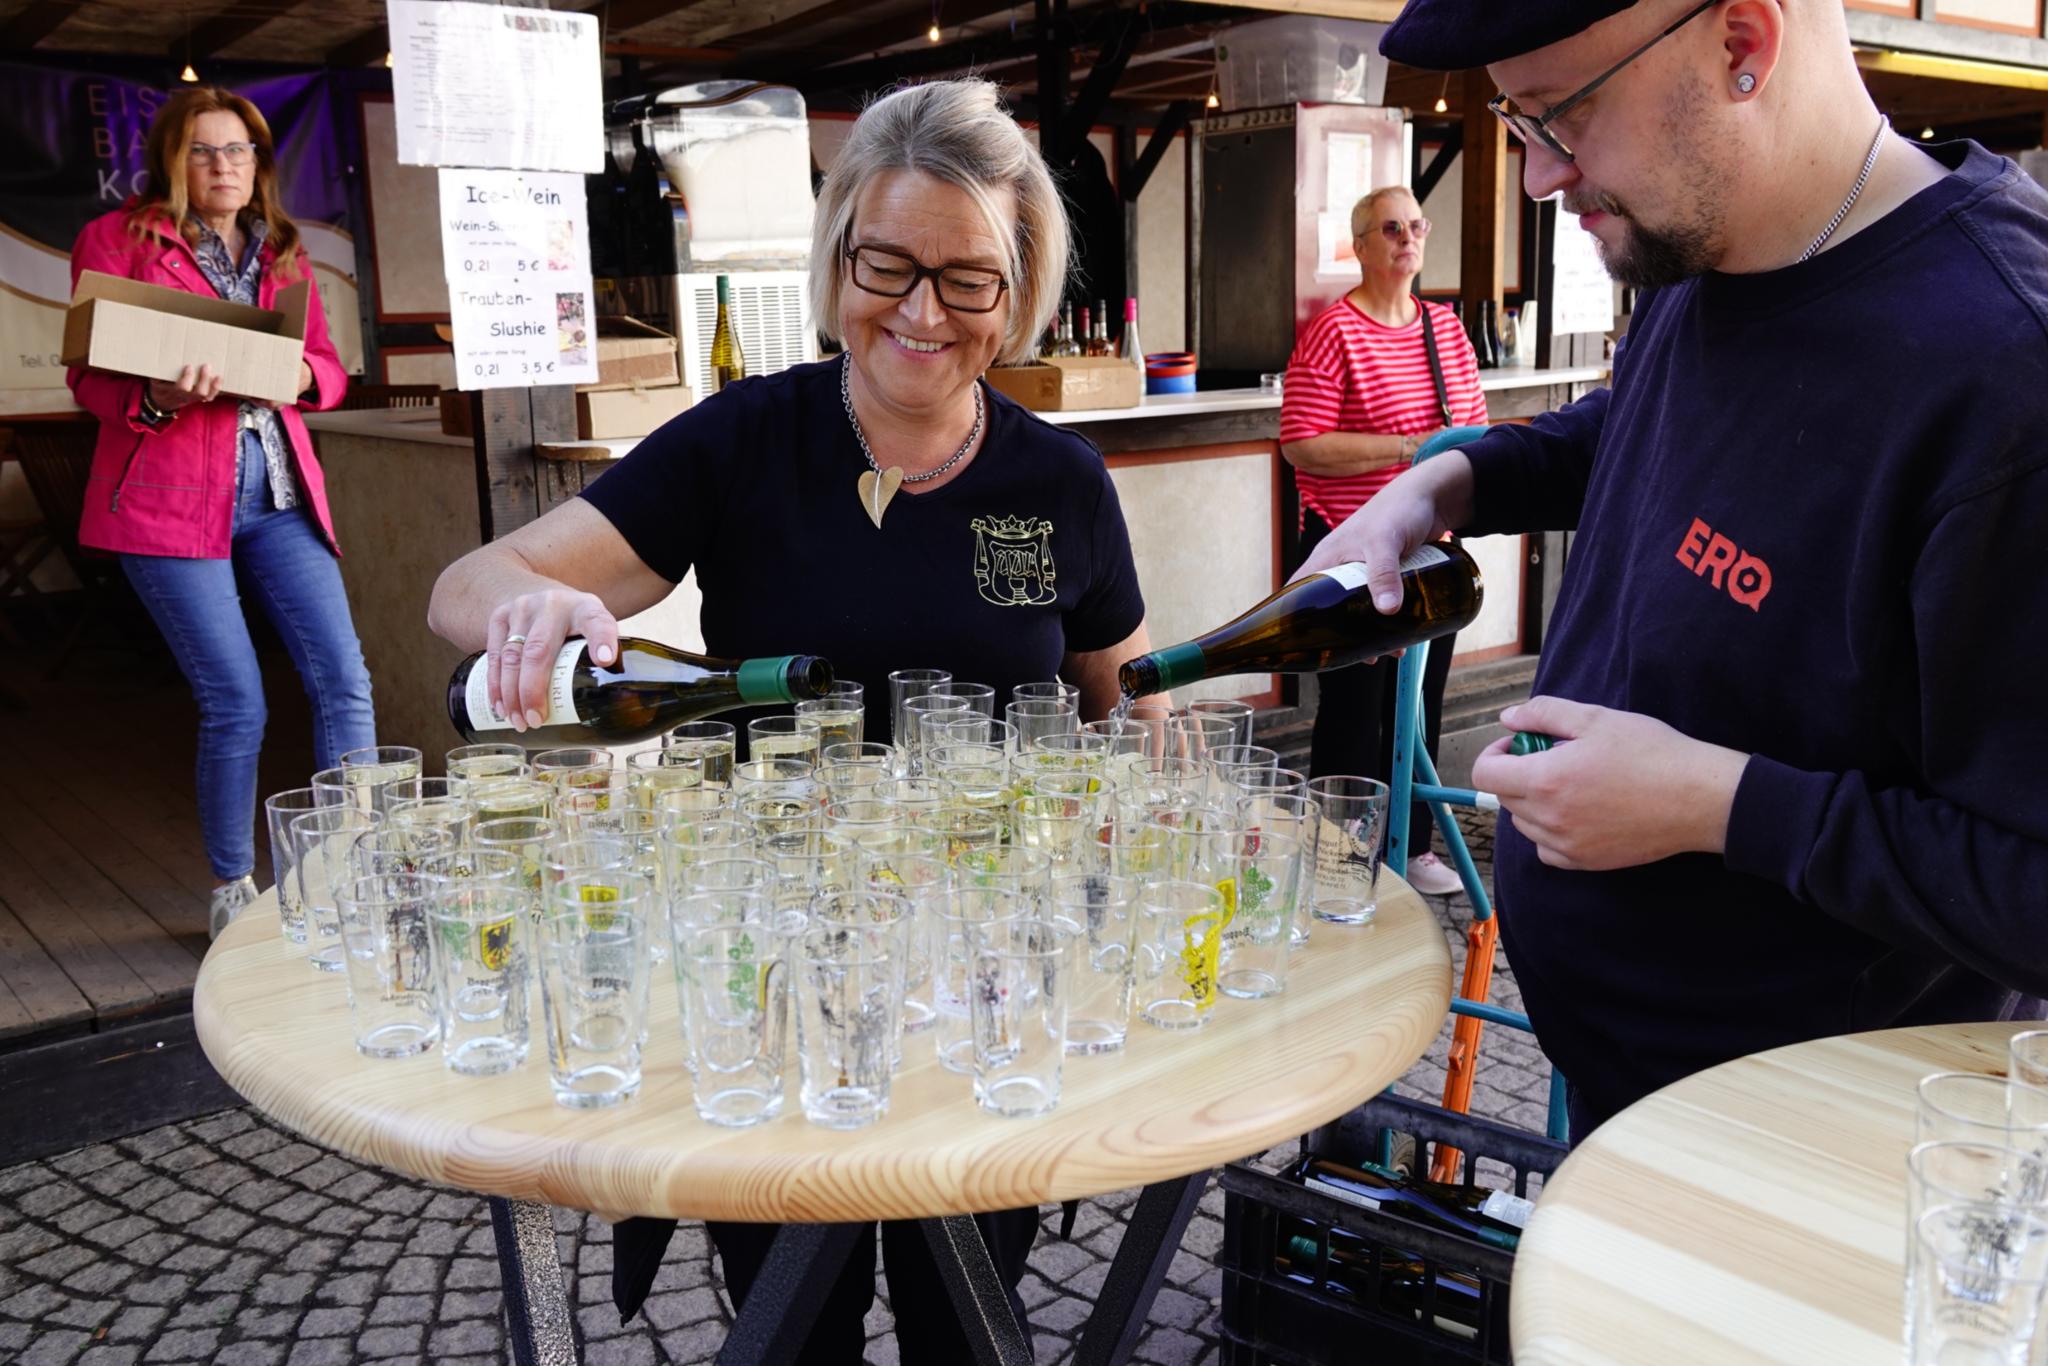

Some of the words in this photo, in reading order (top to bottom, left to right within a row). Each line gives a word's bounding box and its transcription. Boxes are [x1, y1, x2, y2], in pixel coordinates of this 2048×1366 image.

[517, 259, 526, 271] 5
[530, 259, 540, 271] €
[458, 291, 533, 306] Trauben-
[490, 320, 546, 337] Slushie
[521, 362, 542, 375] 3,5
[546, 361, 555, 373] €
[1675, 516, 1772, 612] ERO
